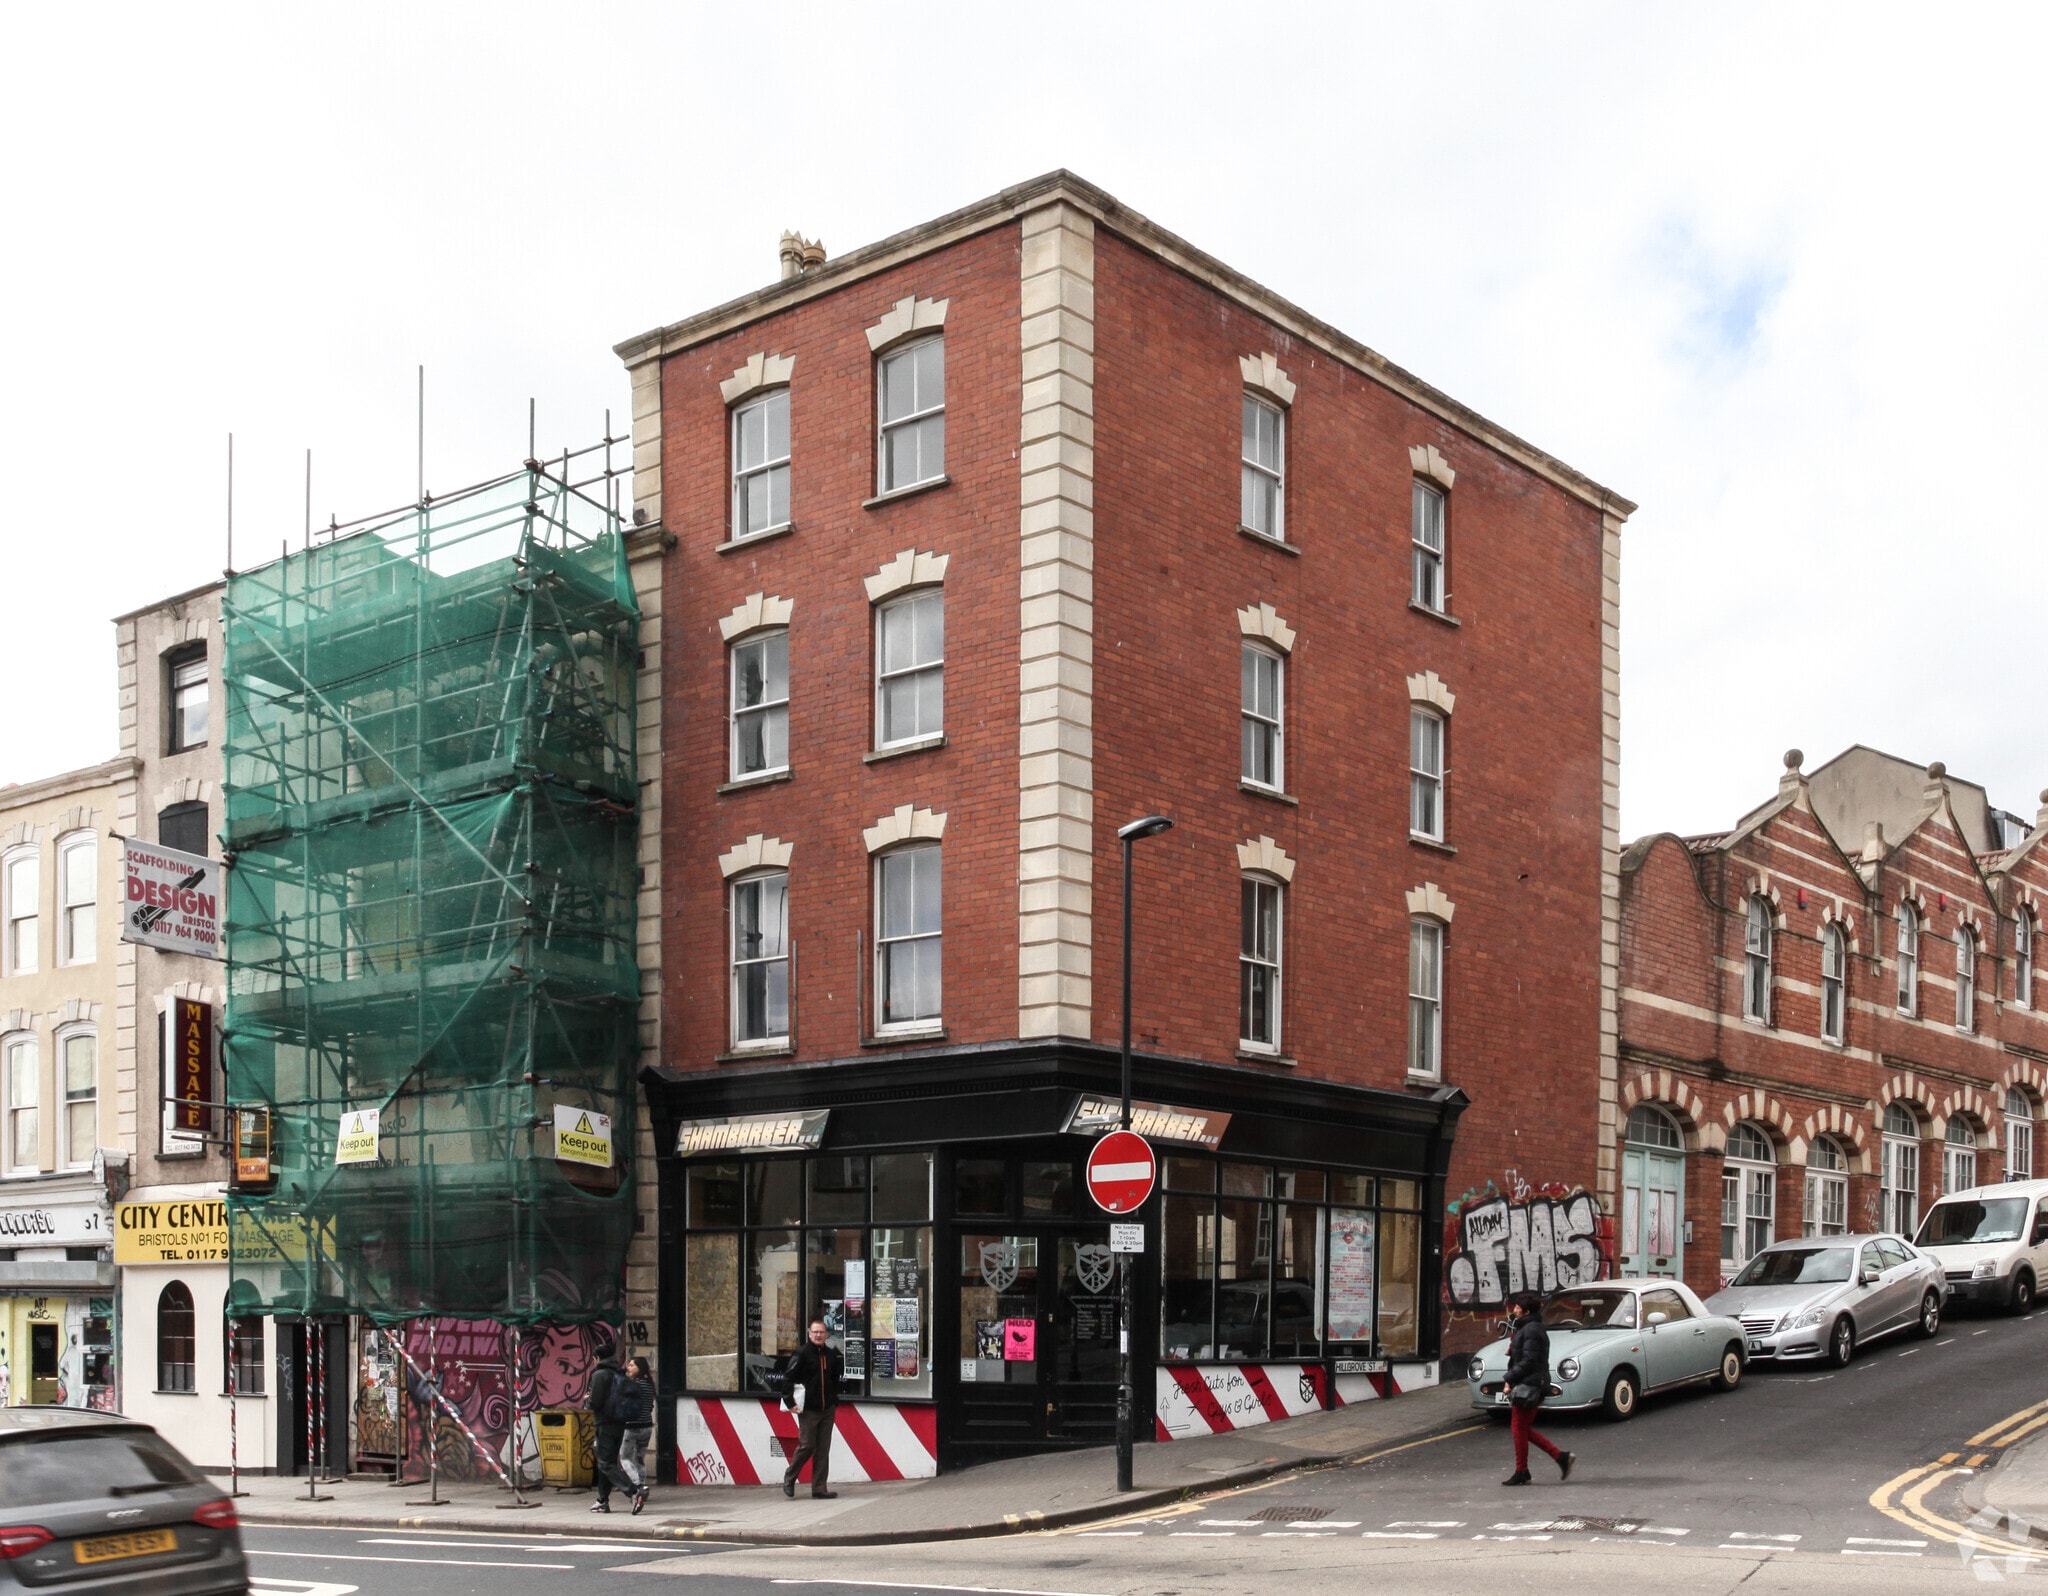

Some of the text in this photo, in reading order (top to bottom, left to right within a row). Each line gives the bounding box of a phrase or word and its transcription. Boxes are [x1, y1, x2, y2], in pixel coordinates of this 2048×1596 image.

[127, 850, 194, 876] SCAFFOLDING
[127, 863, 140, 875] by
[127, 875, 216, 919] DESIGN
[182, 915, 216, 930] BRISTOL
[154, 921, 216, 944] 0117 964 9000
[185, 1003, 202, 1127] MASSAGE
[340, 1136, 374, 1150] Keep out
[561, 1133, 607, 1153] Keep out
[561, 1146, 608, 1162] Dangerous building
[120, 1206, 161, 1229] CITY
[138, 1232, 188, 1246] BRISTOLS
[213, 1232, 236, 1245] FO
[160, 1247, 277, 1260] TEL. 0117 923072
[34, 1298, 48, 1309] ART
[1335, 1361, 1367, 1372] HILLGROVE
[1204, 1375, 1225, 1391] Cuts
[1226, 1373, 1245, 1392] for
